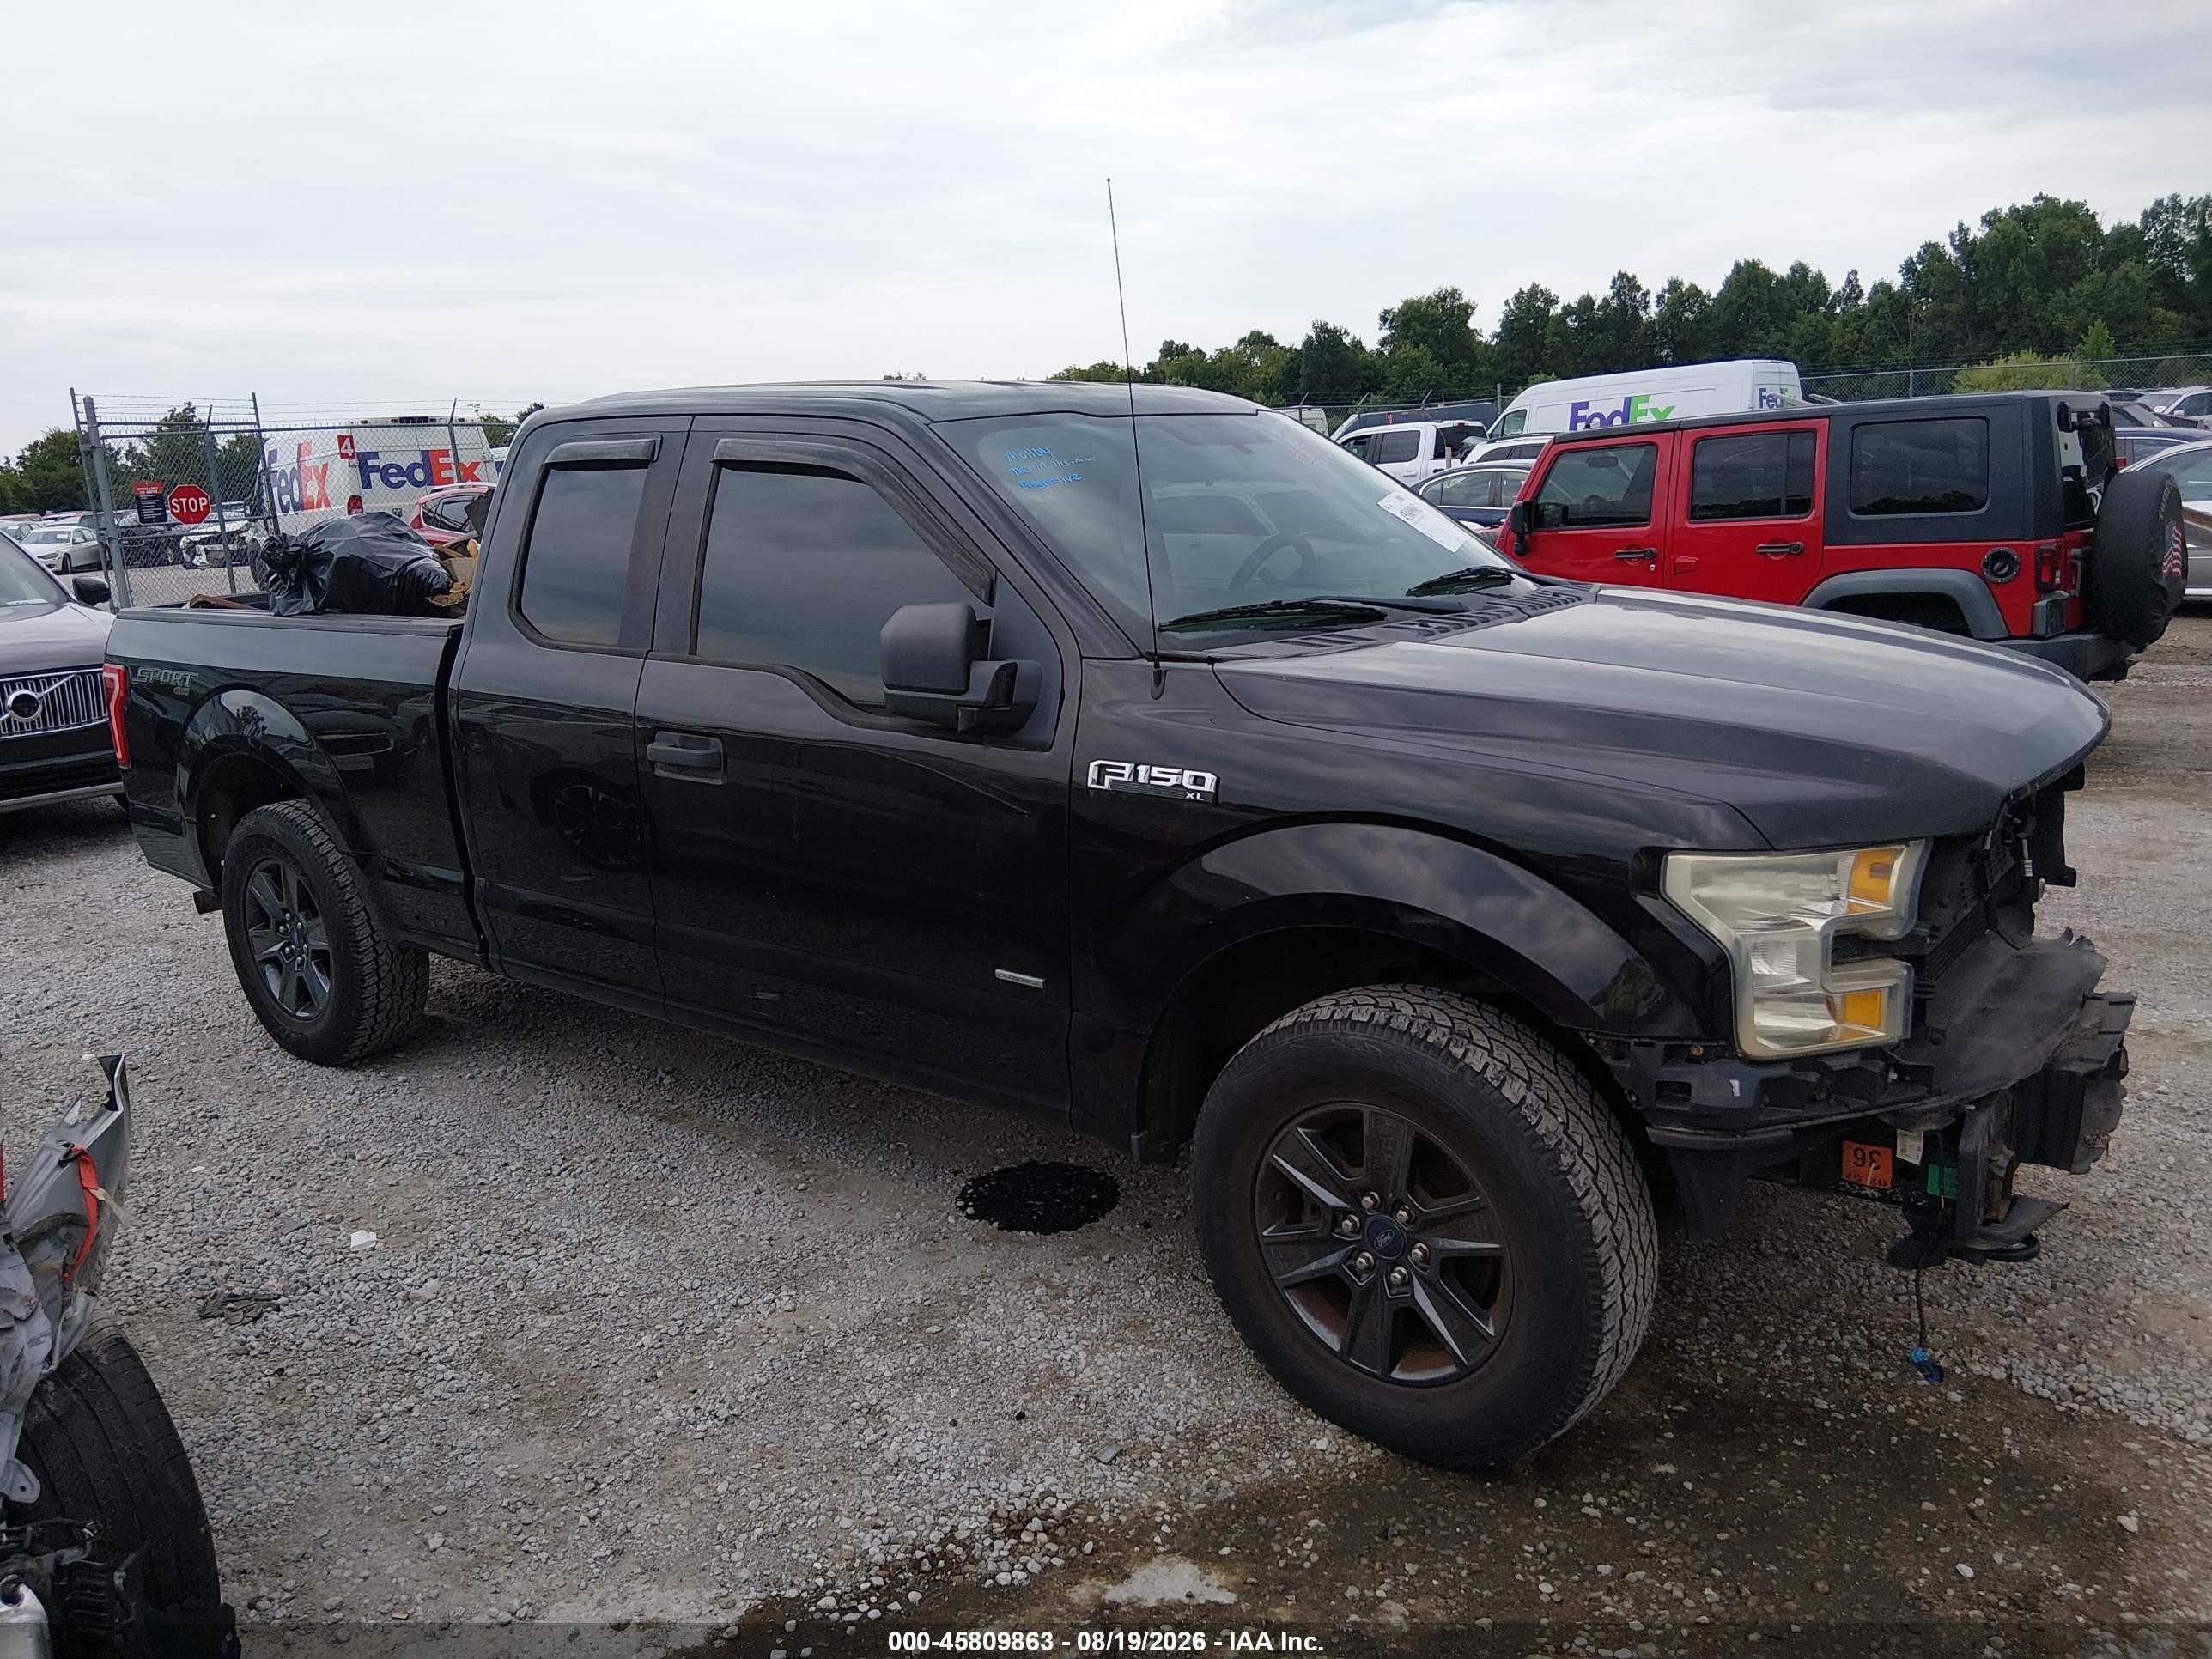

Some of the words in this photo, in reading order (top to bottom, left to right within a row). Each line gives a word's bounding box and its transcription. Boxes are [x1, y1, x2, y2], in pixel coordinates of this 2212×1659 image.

[340, 437, 354, 457] 4
[267, 440, 331, 514] FedEx
[356, 448, 482, 489] FedEx
[171, 496, 208, 514] STOP
[131, 666, 199, 687] SPORT
[1185, 791, 1205, 801] XL
[1853, 1146, 1882, 1170] 36
